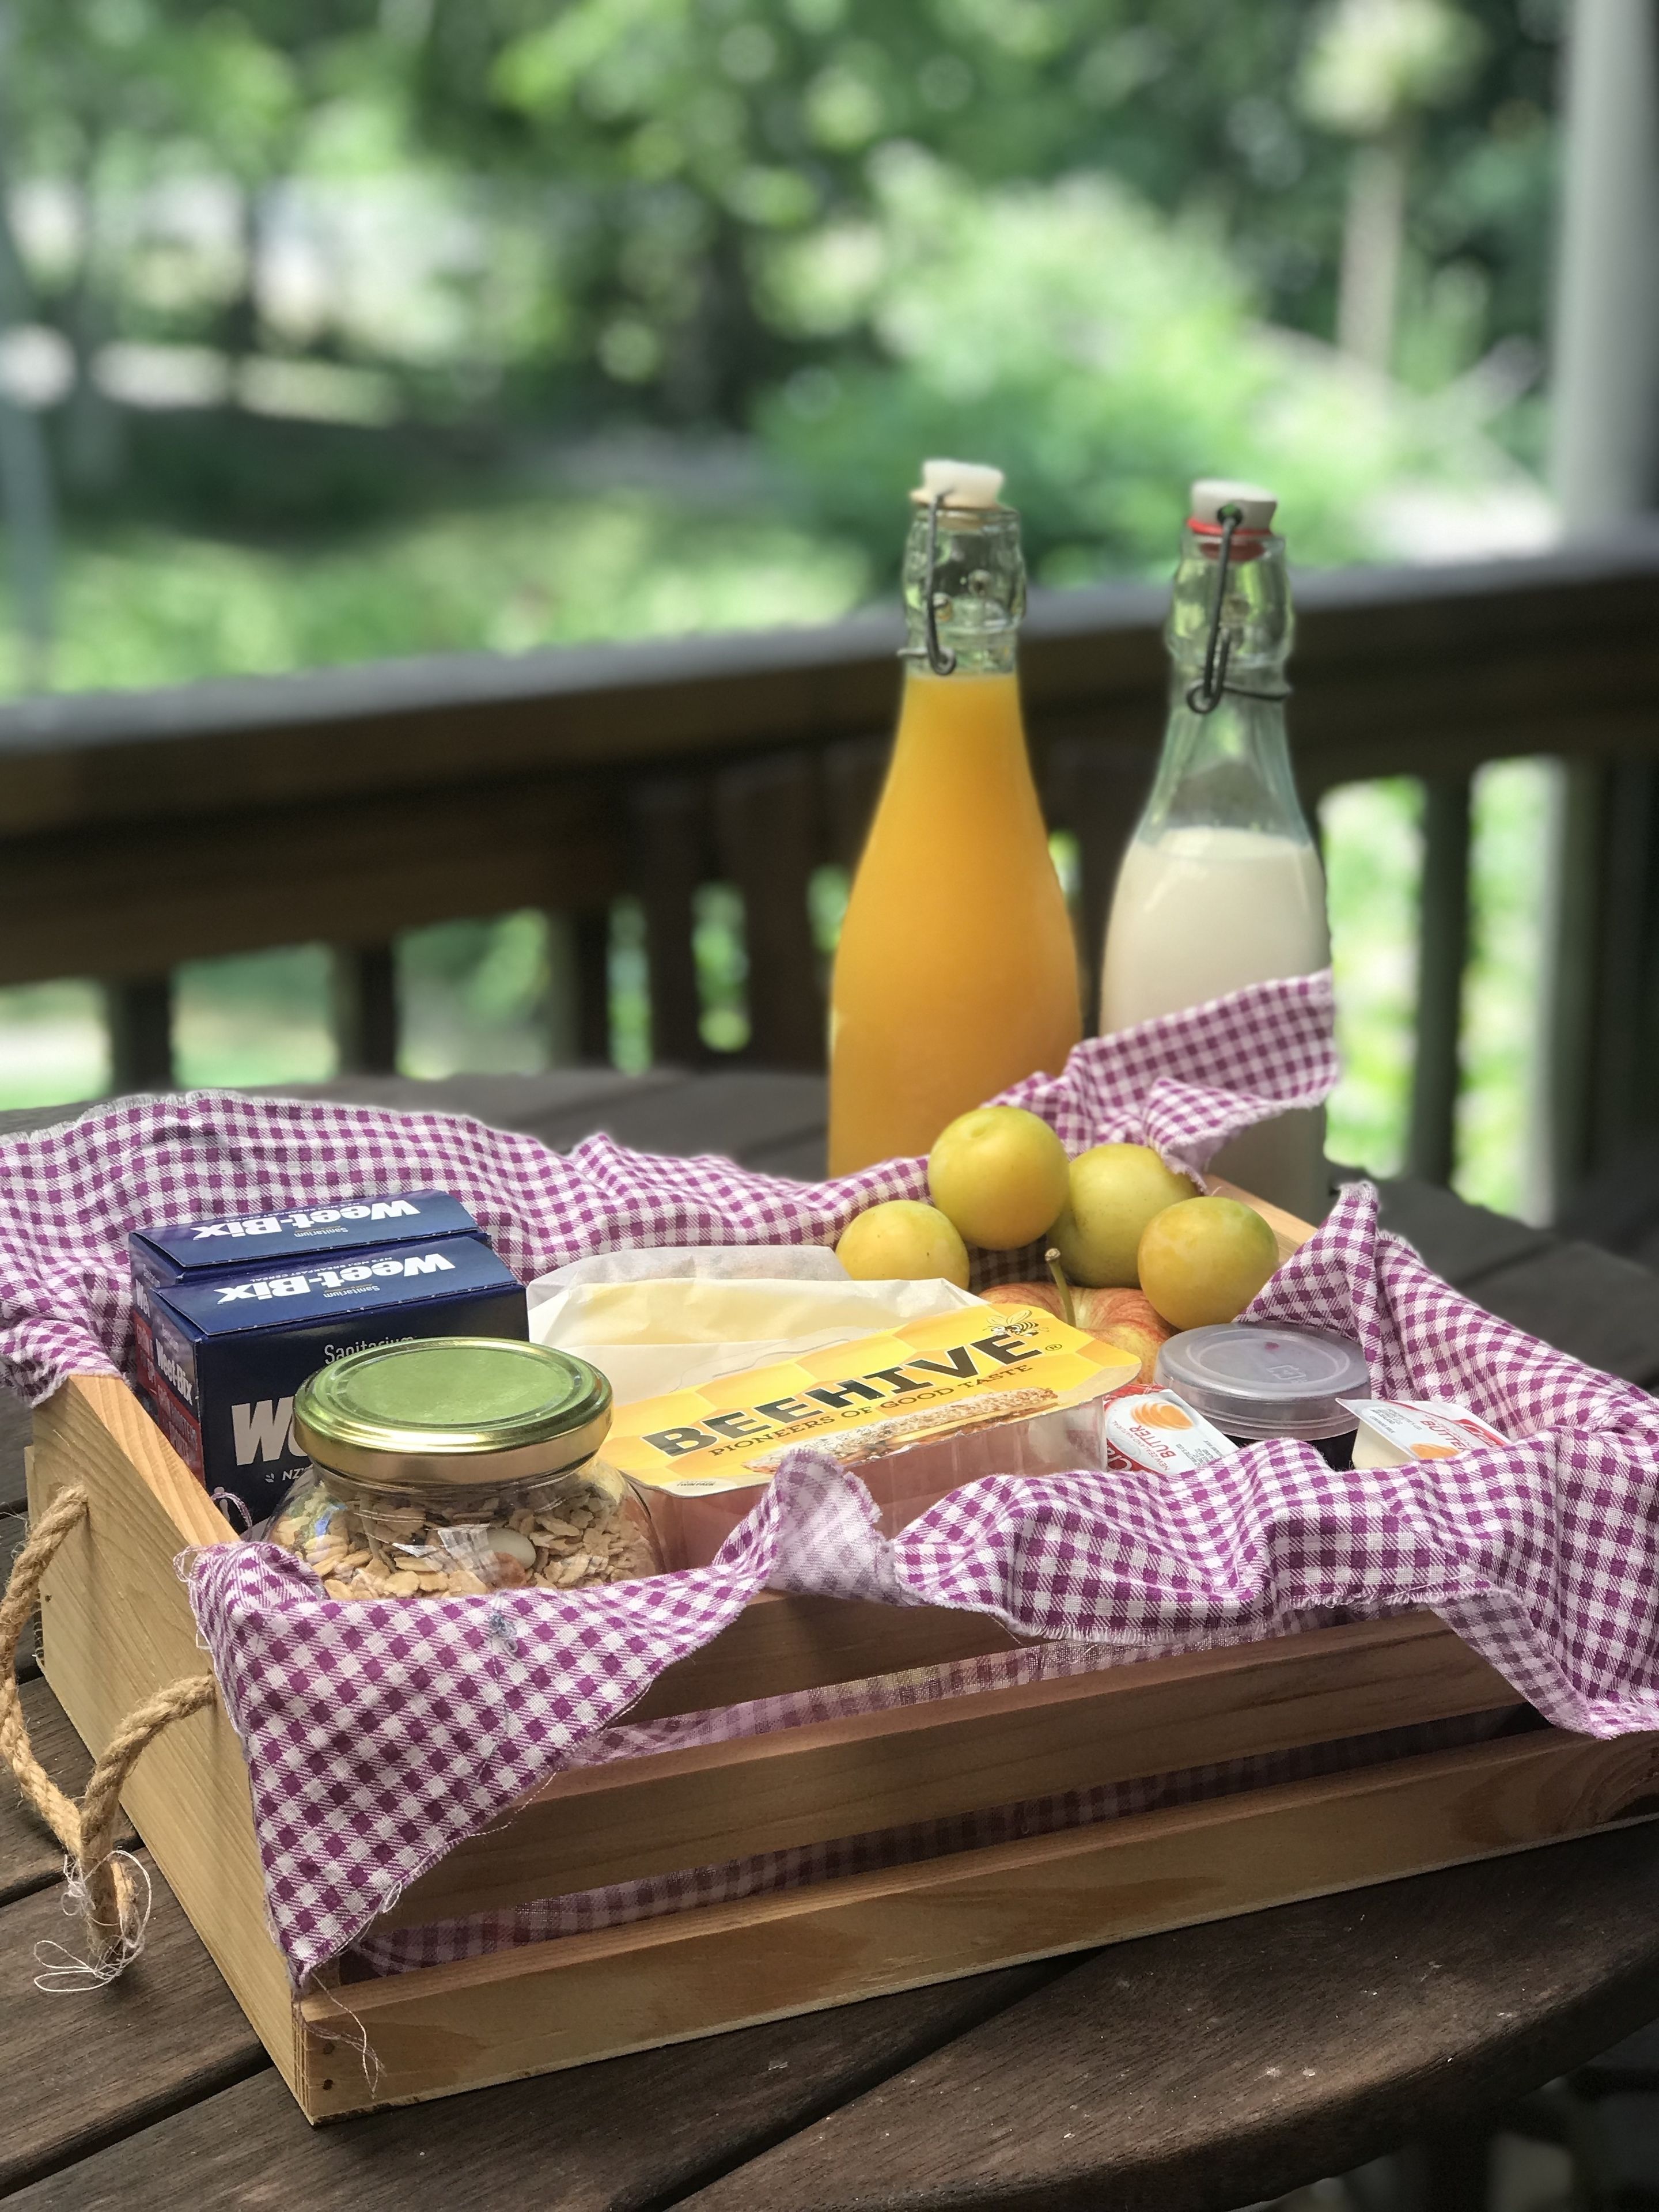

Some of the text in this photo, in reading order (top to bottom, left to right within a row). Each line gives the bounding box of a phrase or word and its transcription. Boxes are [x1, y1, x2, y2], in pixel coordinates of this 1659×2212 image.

[190, 1200, 421, 1238] Weet-Bix
[294, 1227, 349, 1238] Sanitarium
[214, 1253, 456, 1301] Weet-Bix
[249, 1273, 289, 1282] CEREAL
[291, 1264, 346, 1277] BREAKFAST
[323, 1285, 381, 1298] Sanitarium
[156, 1338, 193, 1406] Weet-Bix
[641, 1334, 1043, 1457] BEEHIVE
[707, 1416, 835, 1456] PIONEERS
[840, 1406, 873, 1418] OF
[880, 1388, 955, 1408] GOOD
[957, 1365, 1034, 1389] TASTE
[1129, 1425, 1177, 1459] BUTTER
[1132, 1438, 1158, 1460] ZEALAND
[1154, 1457, 1171, 1471] NEW
